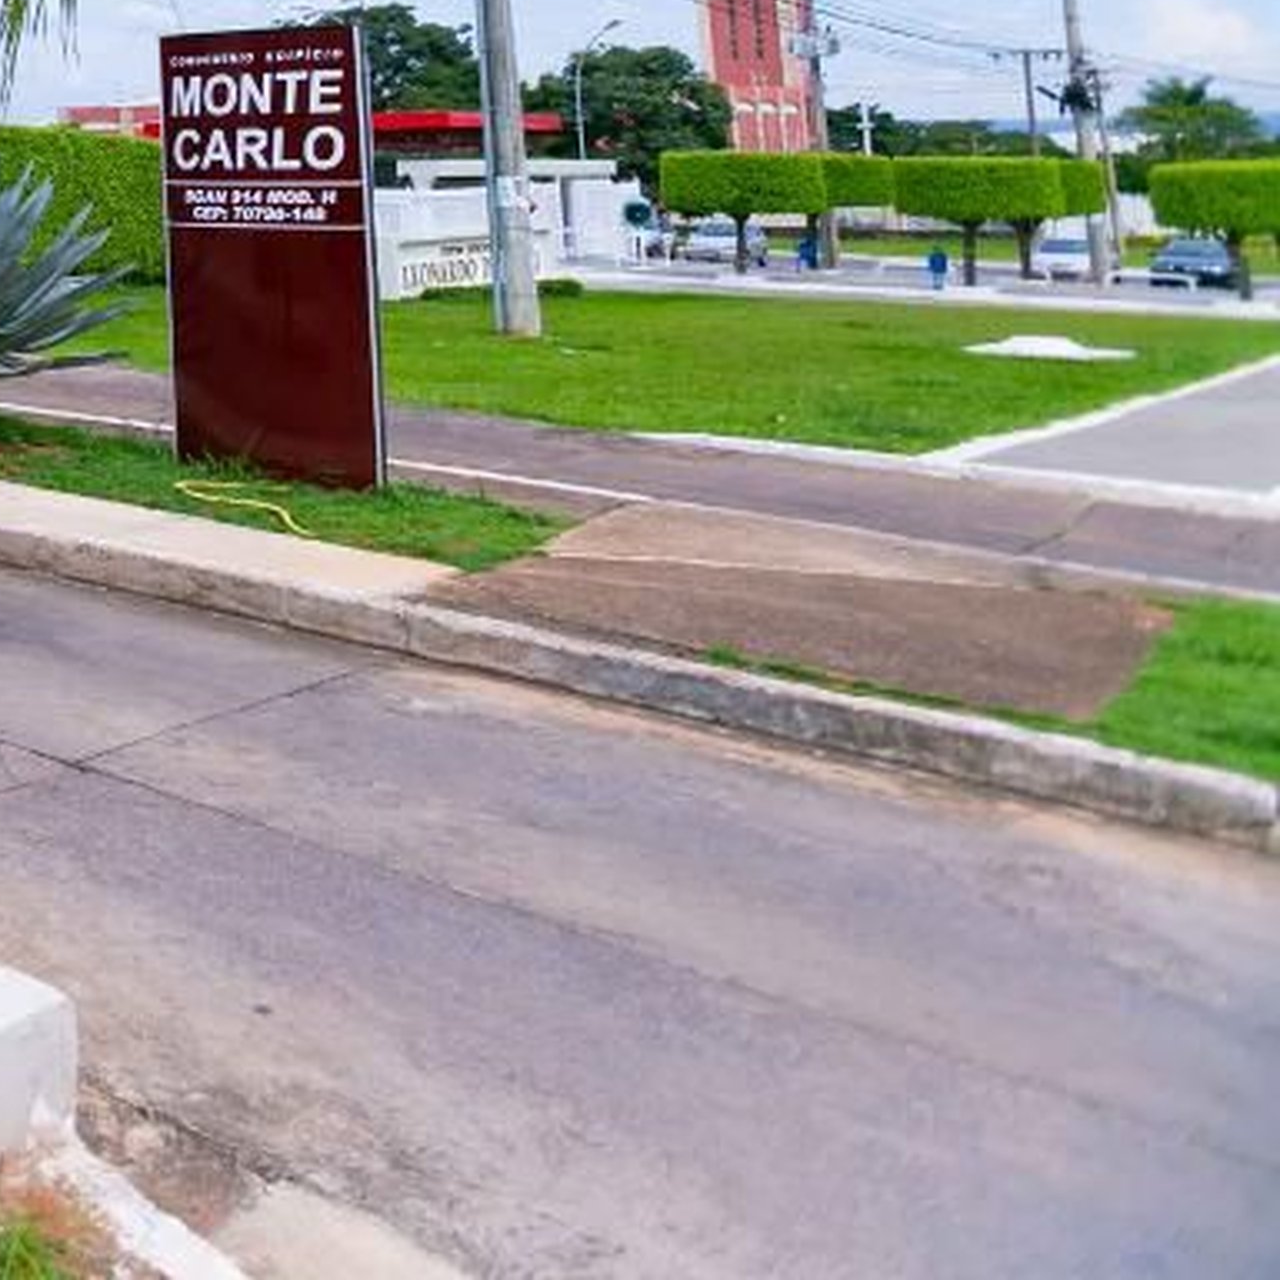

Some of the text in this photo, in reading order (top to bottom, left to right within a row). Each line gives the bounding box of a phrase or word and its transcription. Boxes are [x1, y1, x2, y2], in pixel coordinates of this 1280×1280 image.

[171, 69, 345, 117] MONTE
[172, 124, 345, 171] CARLO
[321, 189, 338, 205] H
